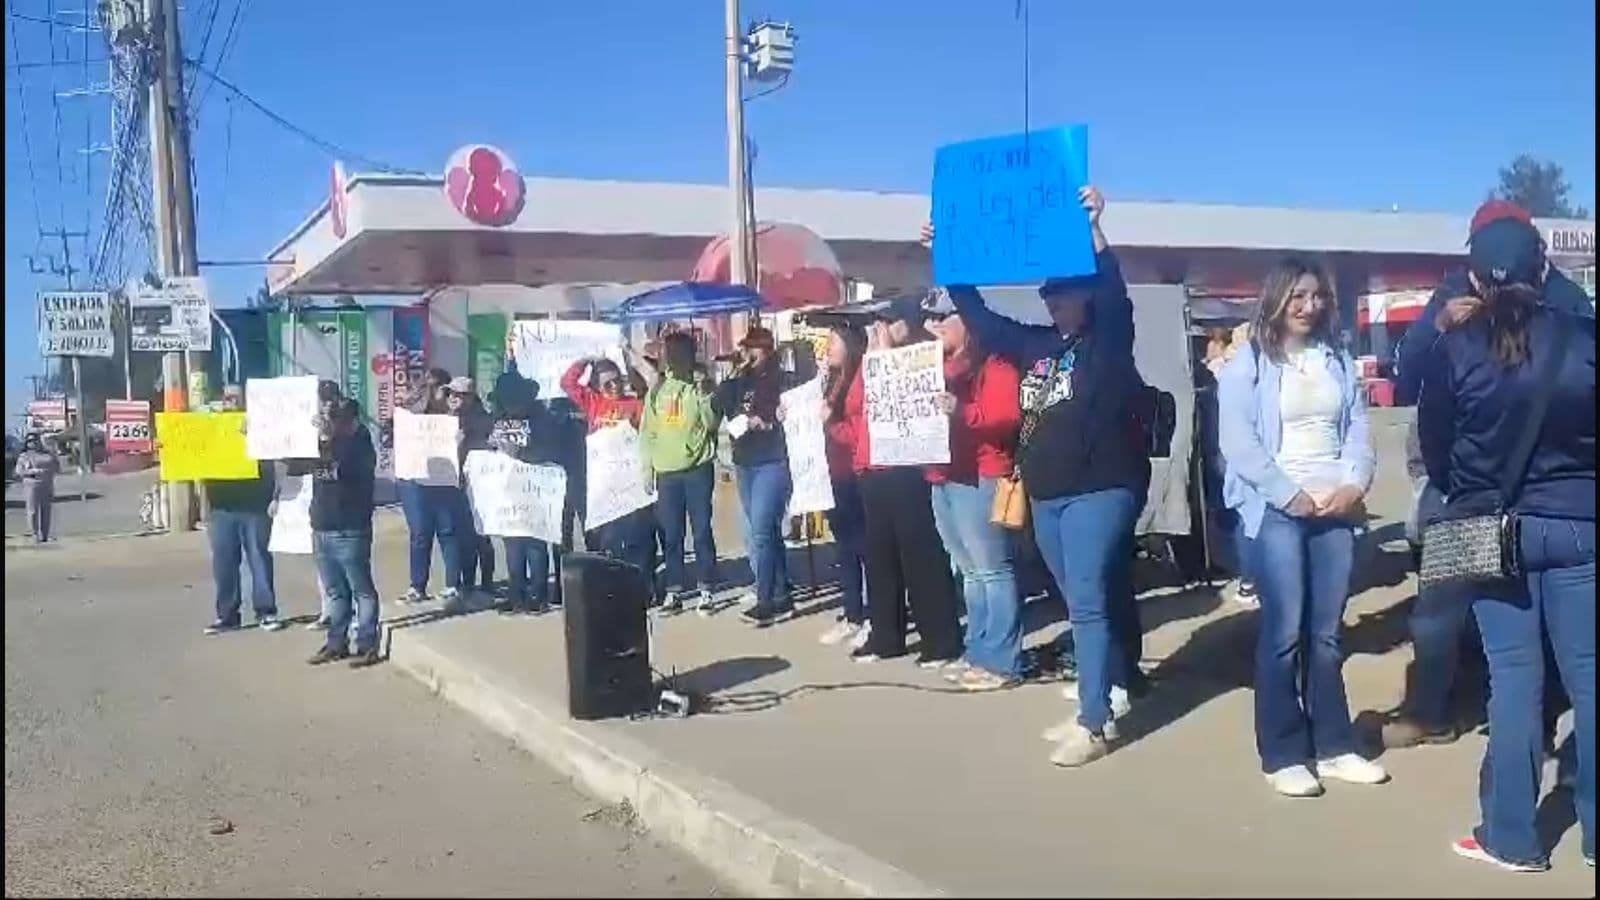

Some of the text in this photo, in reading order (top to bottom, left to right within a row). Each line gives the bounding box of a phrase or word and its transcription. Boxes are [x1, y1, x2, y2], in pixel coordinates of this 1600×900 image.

[979, 186, 1015, 227] Ley
[1026, 166, 1068, 210] del
[43, 297, 104, 311] ENTRADA
[47, 316, 105, 331] Y SALIDA
